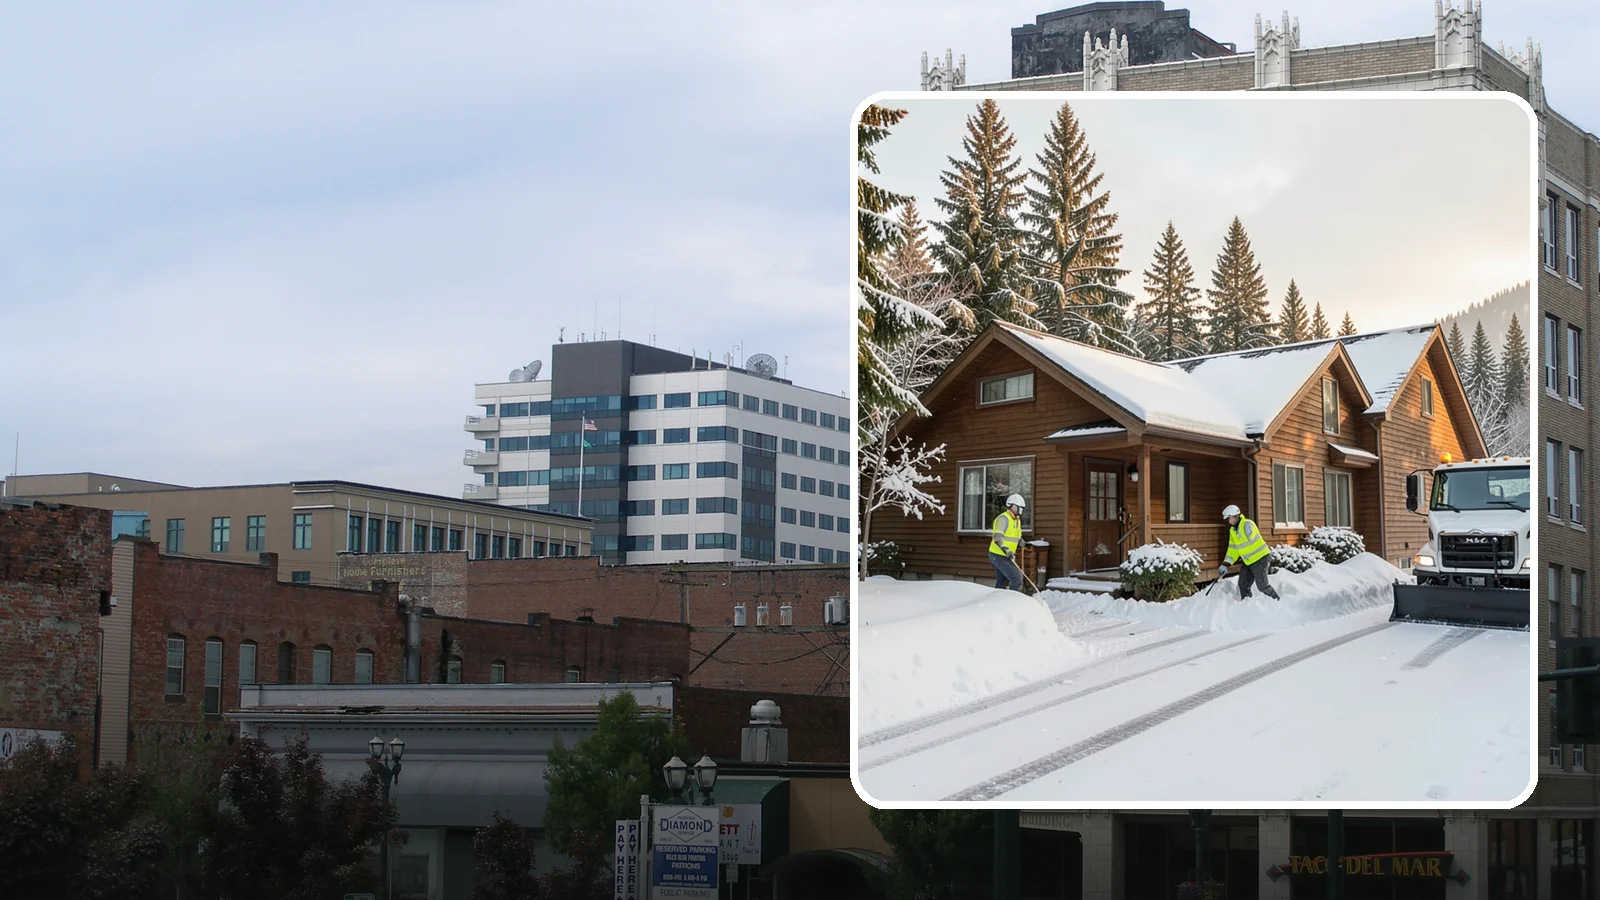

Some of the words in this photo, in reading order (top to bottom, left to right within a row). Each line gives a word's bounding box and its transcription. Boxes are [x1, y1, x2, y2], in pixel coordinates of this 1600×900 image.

[343, 567, 367, 577] Home
[370, 566, 427, 576] Furnishers
[660, 818, 713, 832] DIAMOND
[1022, 815, 1070, 828] BUILDING
[617, 825, 625, 852] PAY
[628, 825, 636, 852] PAY
[689, 846, 716, 854] PARKING
[617, 856, 625, 893] HERE
[628, 856, 636, 893] HERE
[1346, 856, 1385, 876] DEL
[1392, 857, 1442, 877] MAR
[660, 888, 682, 897] PUBLIC
[684, 889, 710, 898] PARKING
